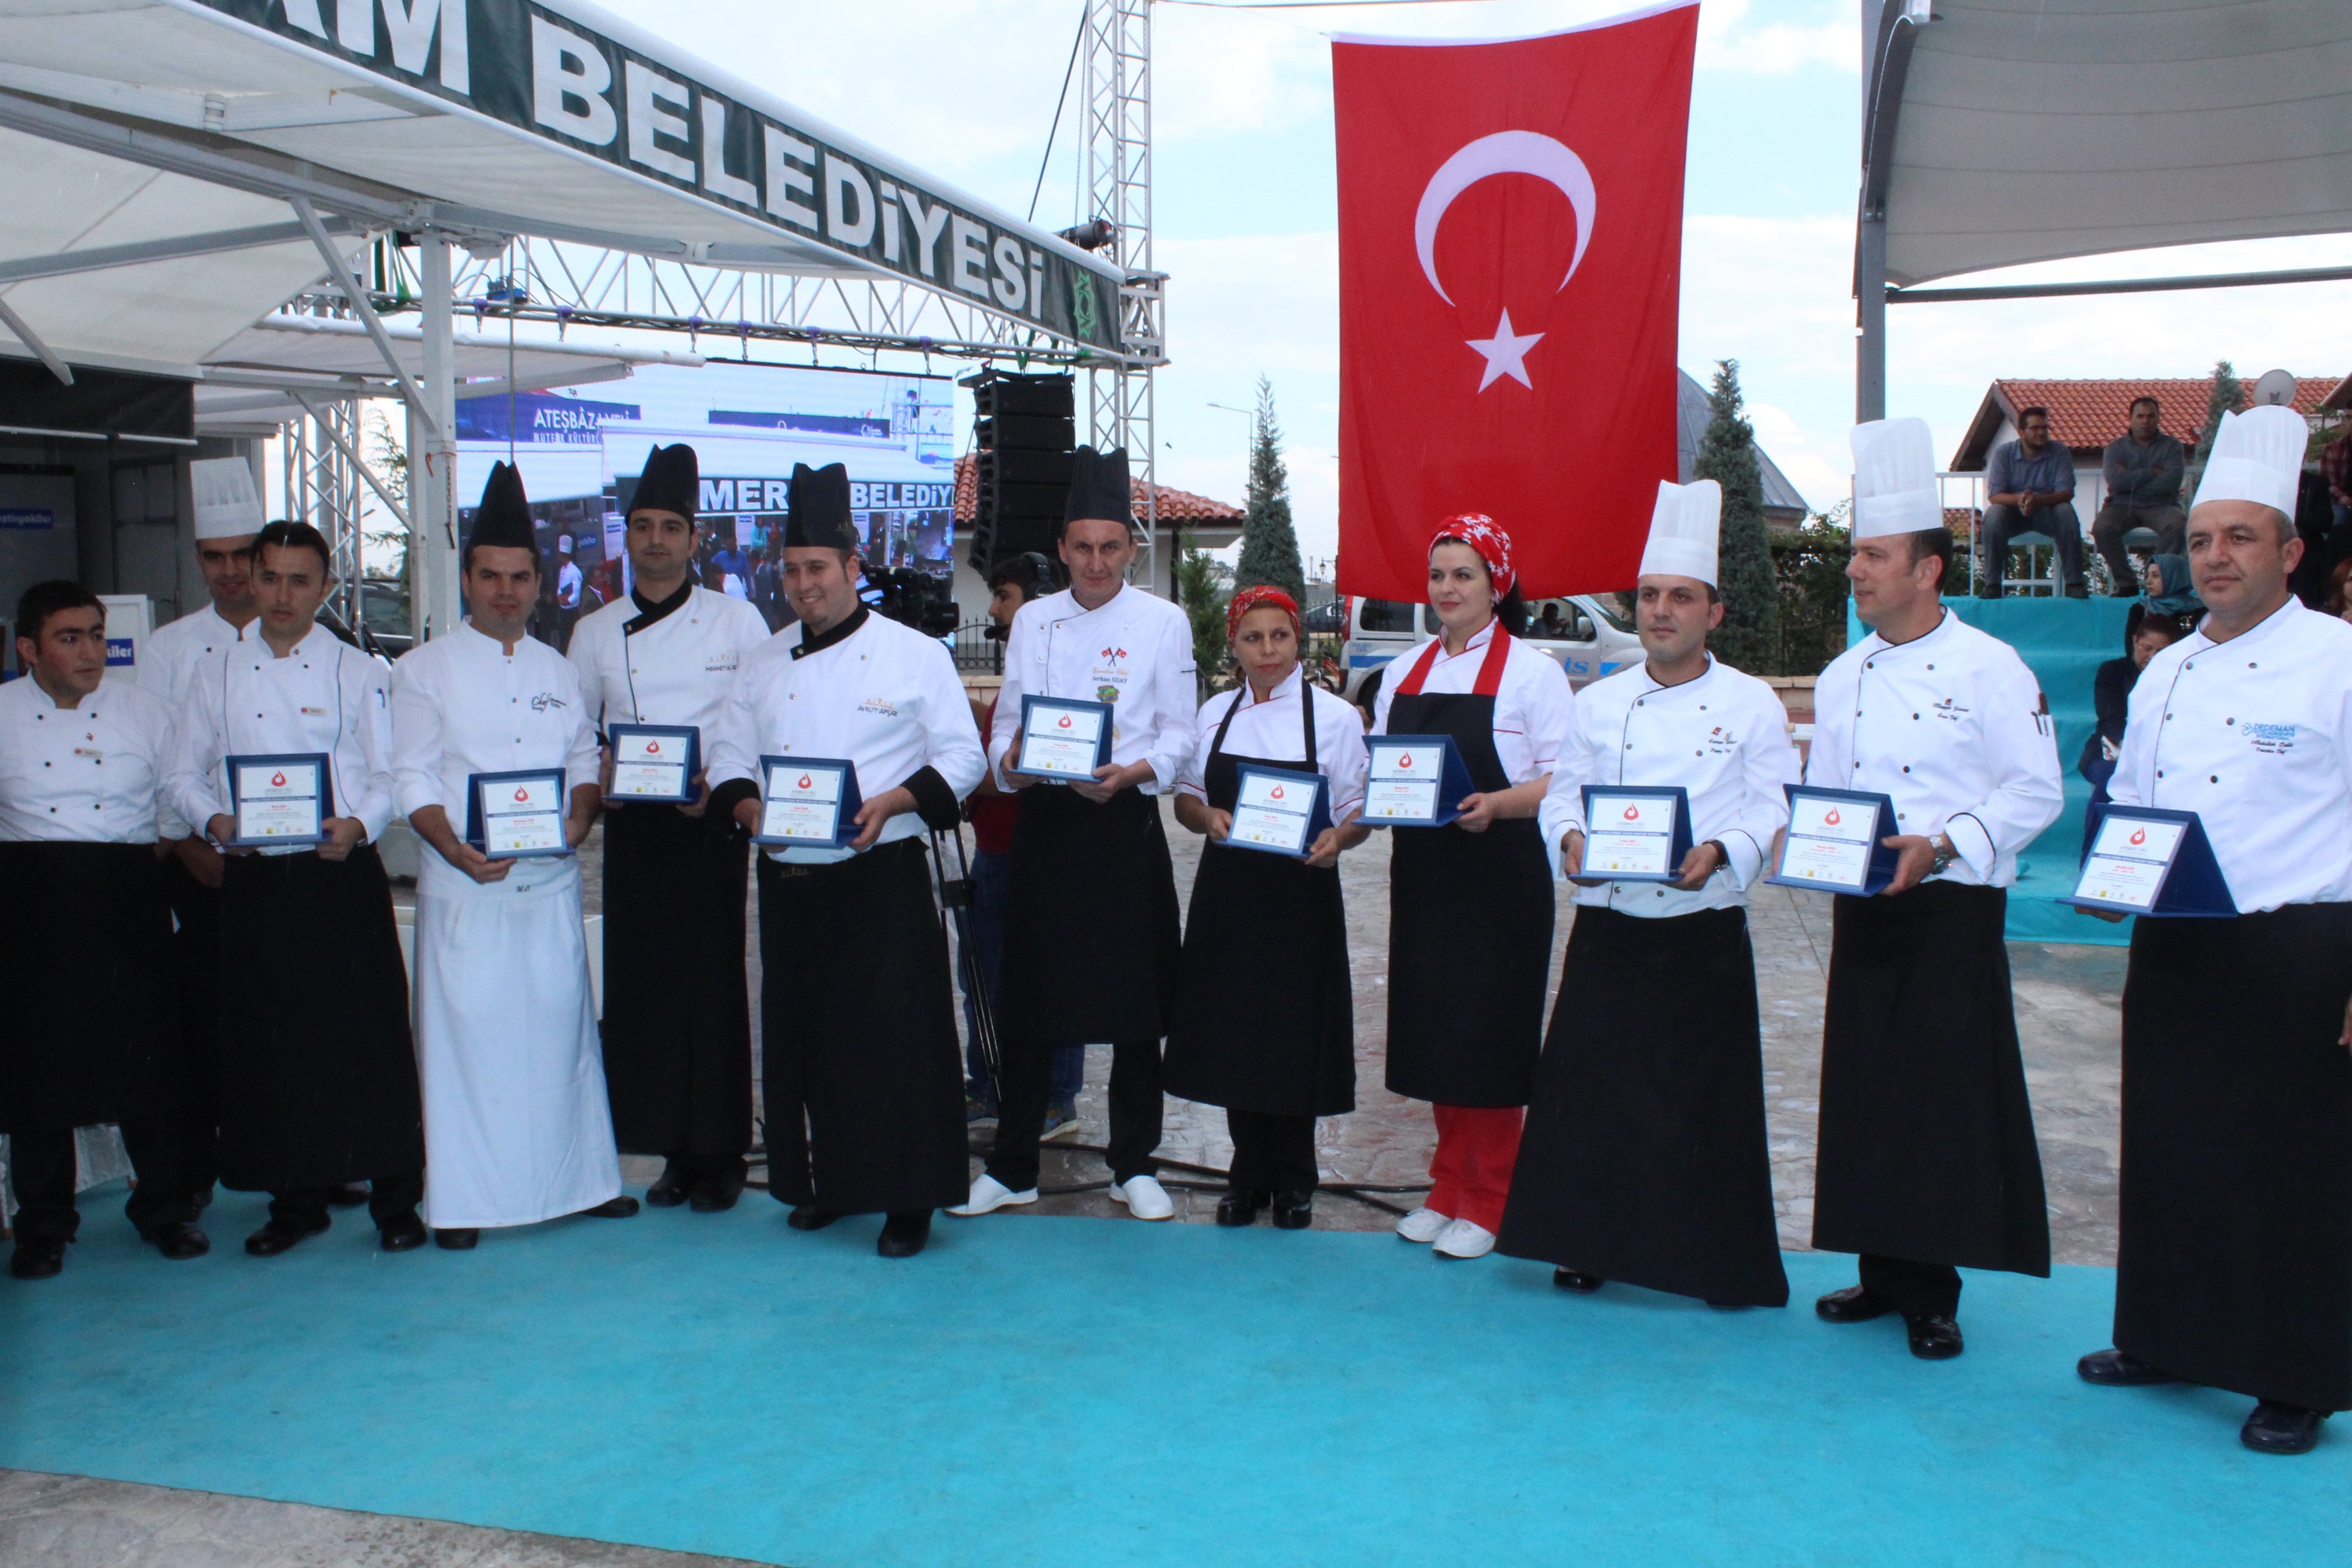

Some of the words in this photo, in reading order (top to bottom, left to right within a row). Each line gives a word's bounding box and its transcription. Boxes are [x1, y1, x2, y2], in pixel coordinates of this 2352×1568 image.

[267, 0, 470, 97] M
[534, 406, 602, 434] ATEŞBÂZ
[2254, 724, 2295, 732] DEDEMAN
